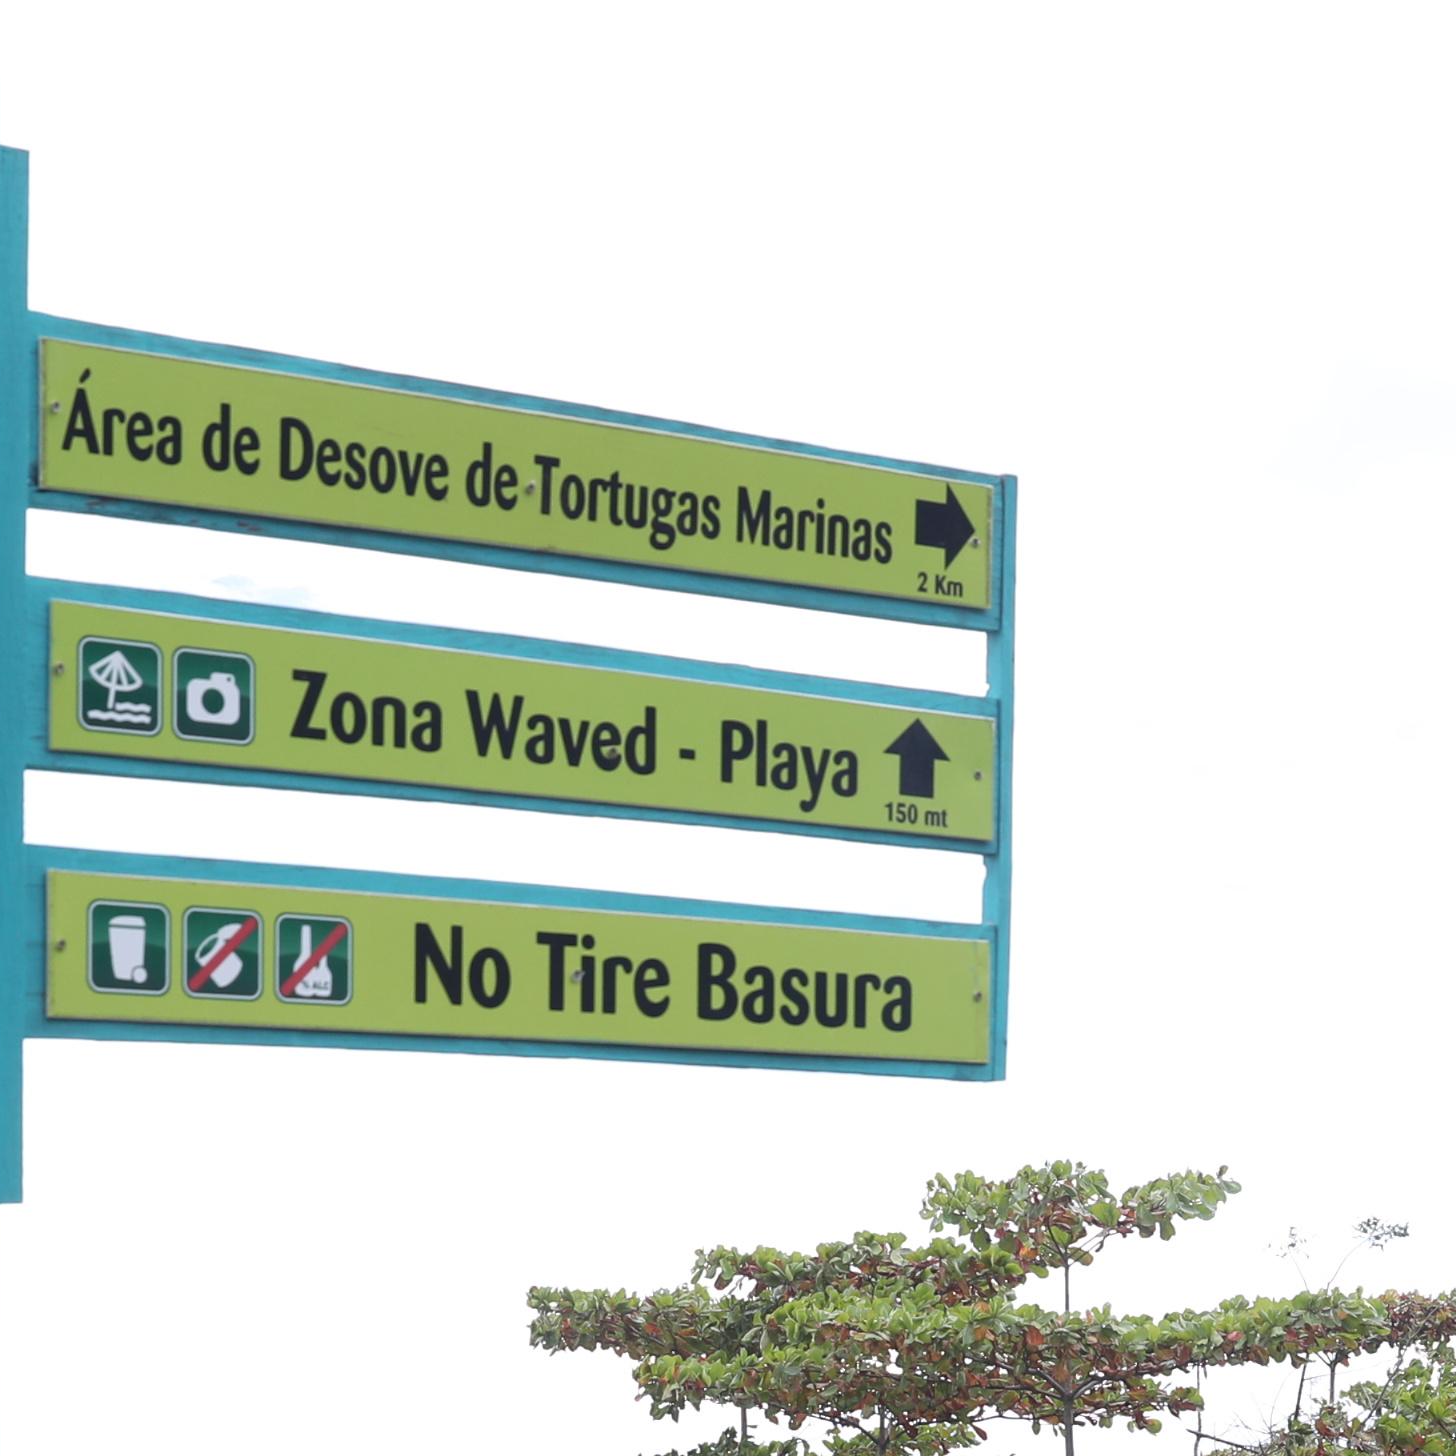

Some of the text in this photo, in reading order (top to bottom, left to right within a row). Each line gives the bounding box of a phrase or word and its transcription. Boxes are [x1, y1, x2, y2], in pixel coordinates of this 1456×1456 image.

[62, 368, 892, 564] Área de Desove de Tortugas Marinas
[917, 572, 962, 597] 2 Km
[290, 669, 442, 754] Zona
[465, 689, 656, 776] Waved
[721, 720, 858, 814] Playa
[884, 801, 947, 827] 150 mt
[415, 922, 912, 1033] No Tire Basura
